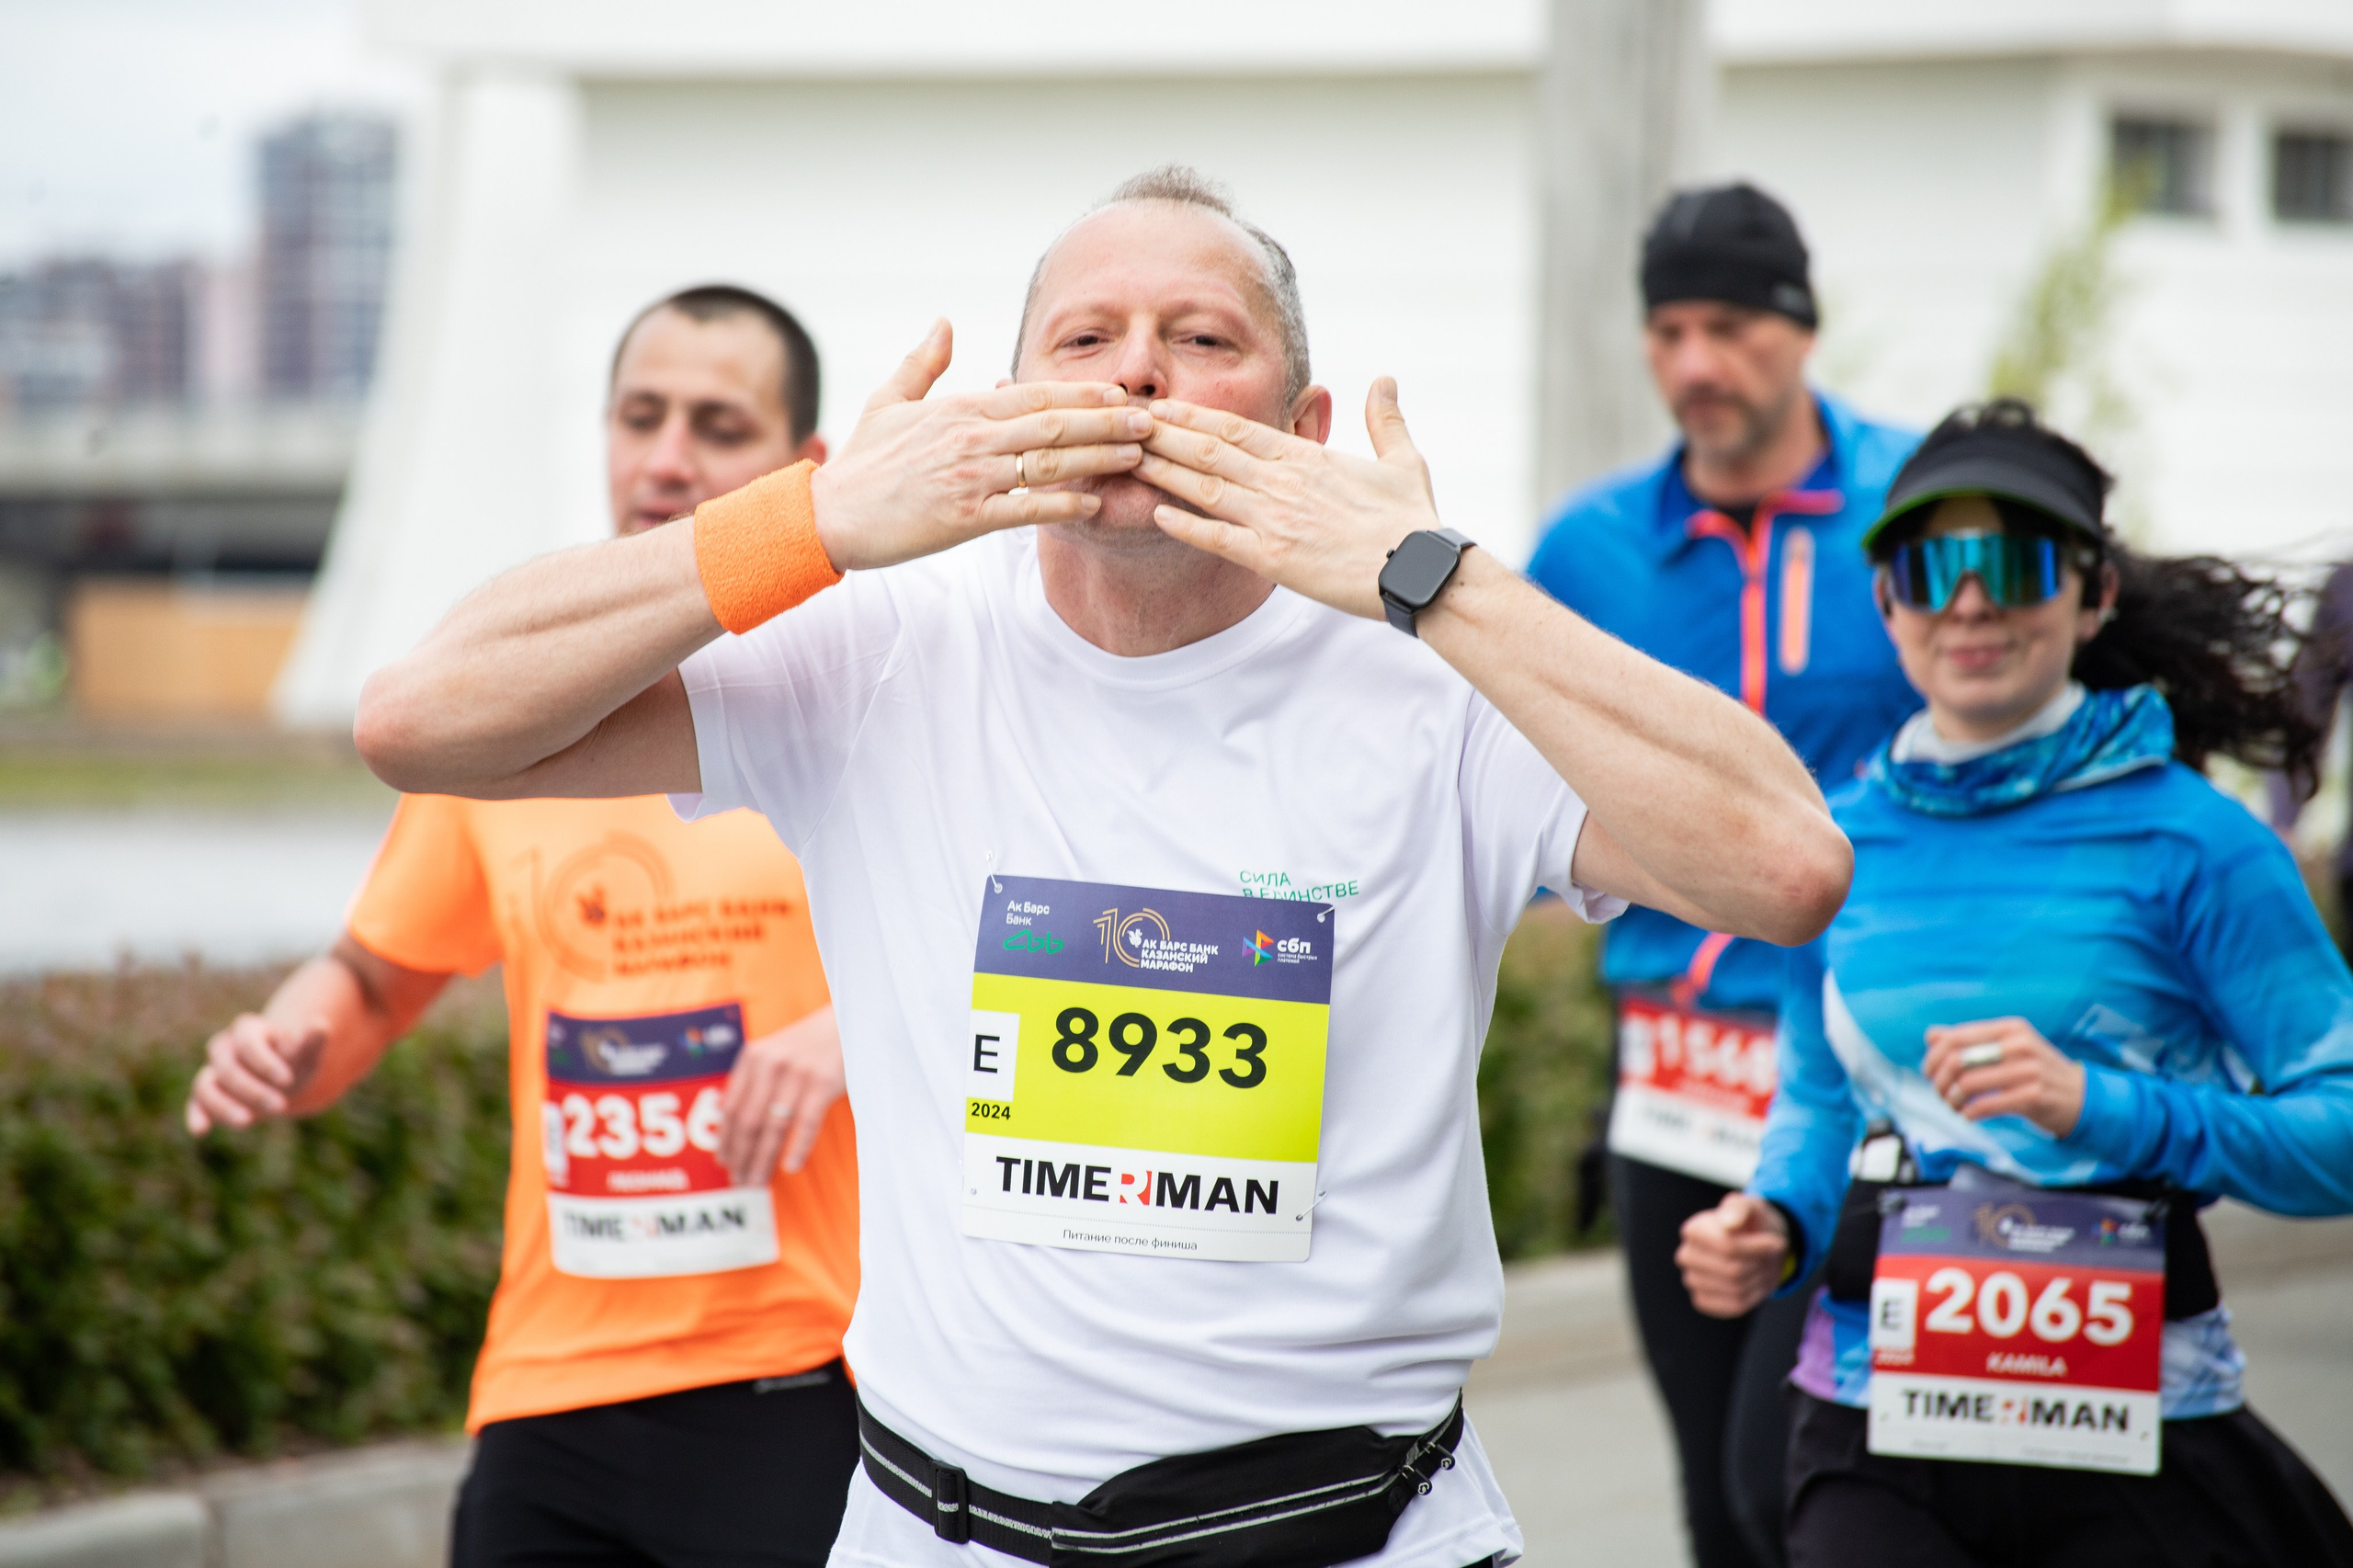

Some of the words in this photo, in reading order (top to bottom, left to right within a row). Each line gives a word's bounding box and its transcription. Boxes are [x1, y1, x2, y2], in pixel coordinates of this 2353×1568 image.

[1239, 870, 1291, 887] СИЛА
[1007, 900, 1022, 912] Ак
[1023, 902, 1051, 916] Барс
[1006, 913, 1032, 926] Банк
[1142, 938, 1157, 949] АК
[1159, 940, 1188, 953] БАРС
[1189, 943, 1219, 956] БАНК
[1141, 949, 1209, 965] КАЗАНСКИЙ
[1141, 959, 1194, 973] МАРАФОН
[973, 1034, 1001, 1074] E
[1051, 1006, 1268, 1089] 8933
[971, 1102, 1011, 1120] 2024
[562, 1087, 723, 1160] 2356
[1063, 1229, 1111, 1243] Питание
[1114, 1235, 1149, 1246] после
[1151, 1237, 1198, 1250] финиша
[1880, 1297, 1903, 1331] E
[1925, 1267, 2135, 1346] 2065
[1985, 1351, 2068, 1377] KAMILA
